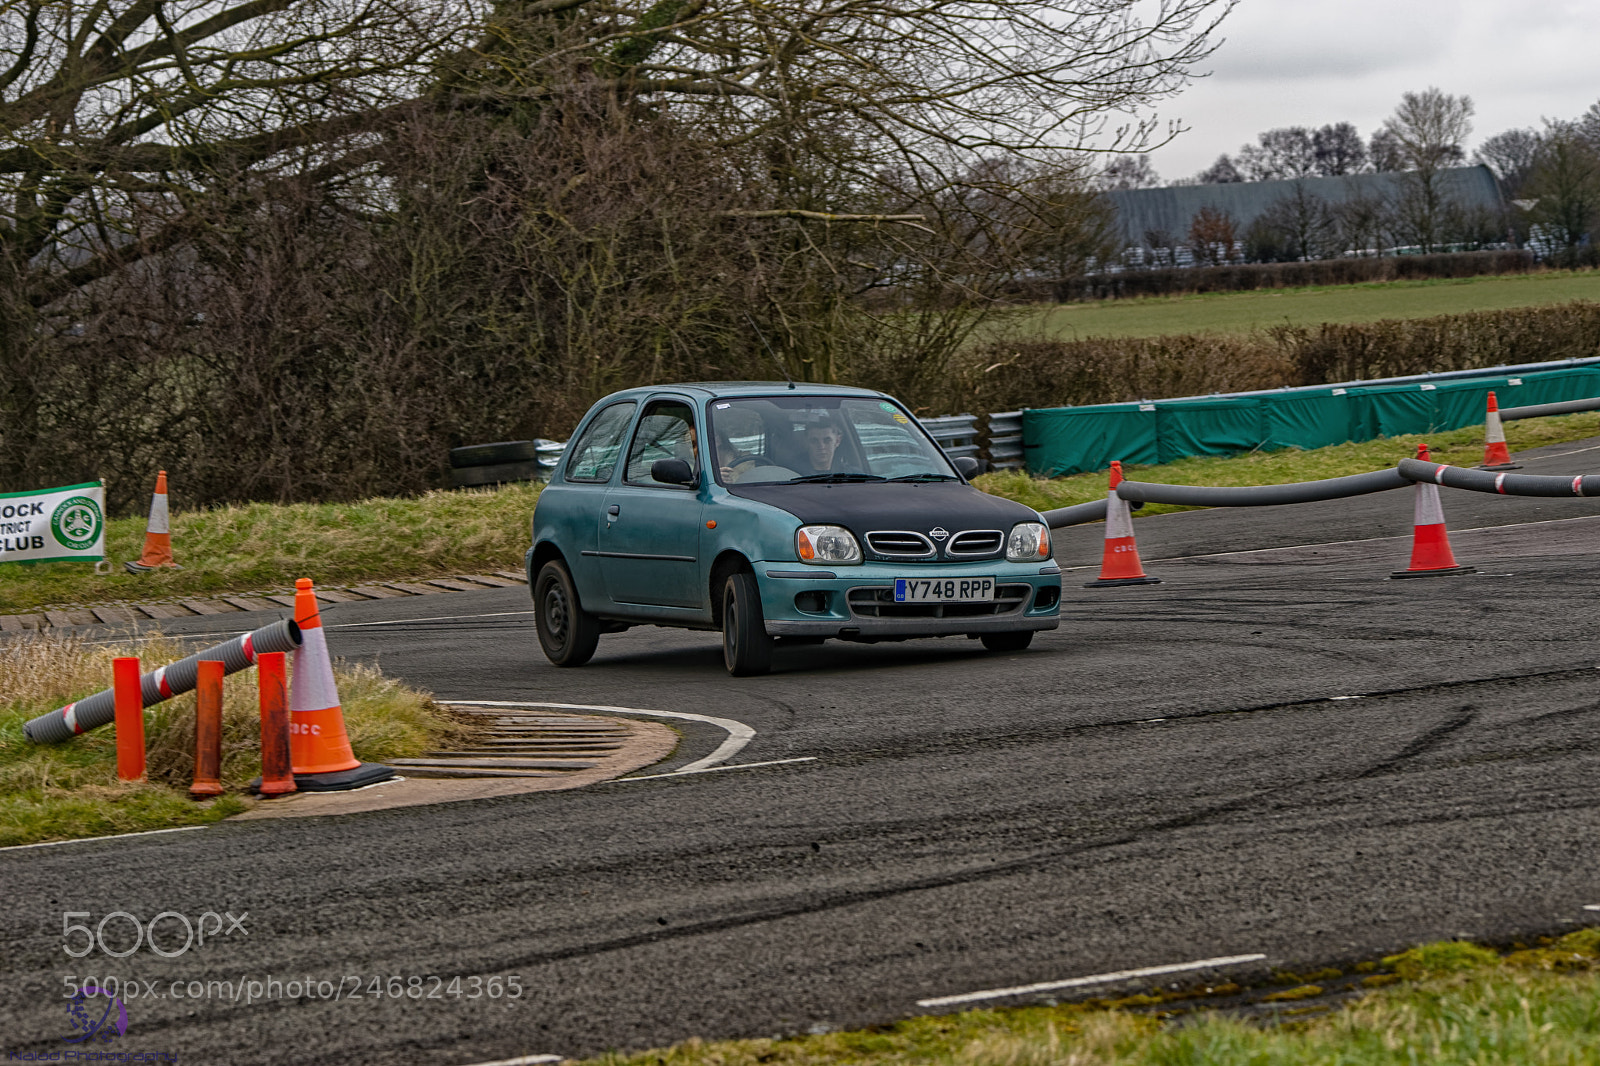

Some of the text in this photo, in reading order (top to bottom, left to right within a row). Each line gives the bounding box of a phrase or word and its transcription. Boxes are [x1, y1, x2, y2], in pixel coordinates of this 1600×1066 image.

[0, 501, 45, 518] OCK
[908, 580, 992, 599] Y748 RPP
